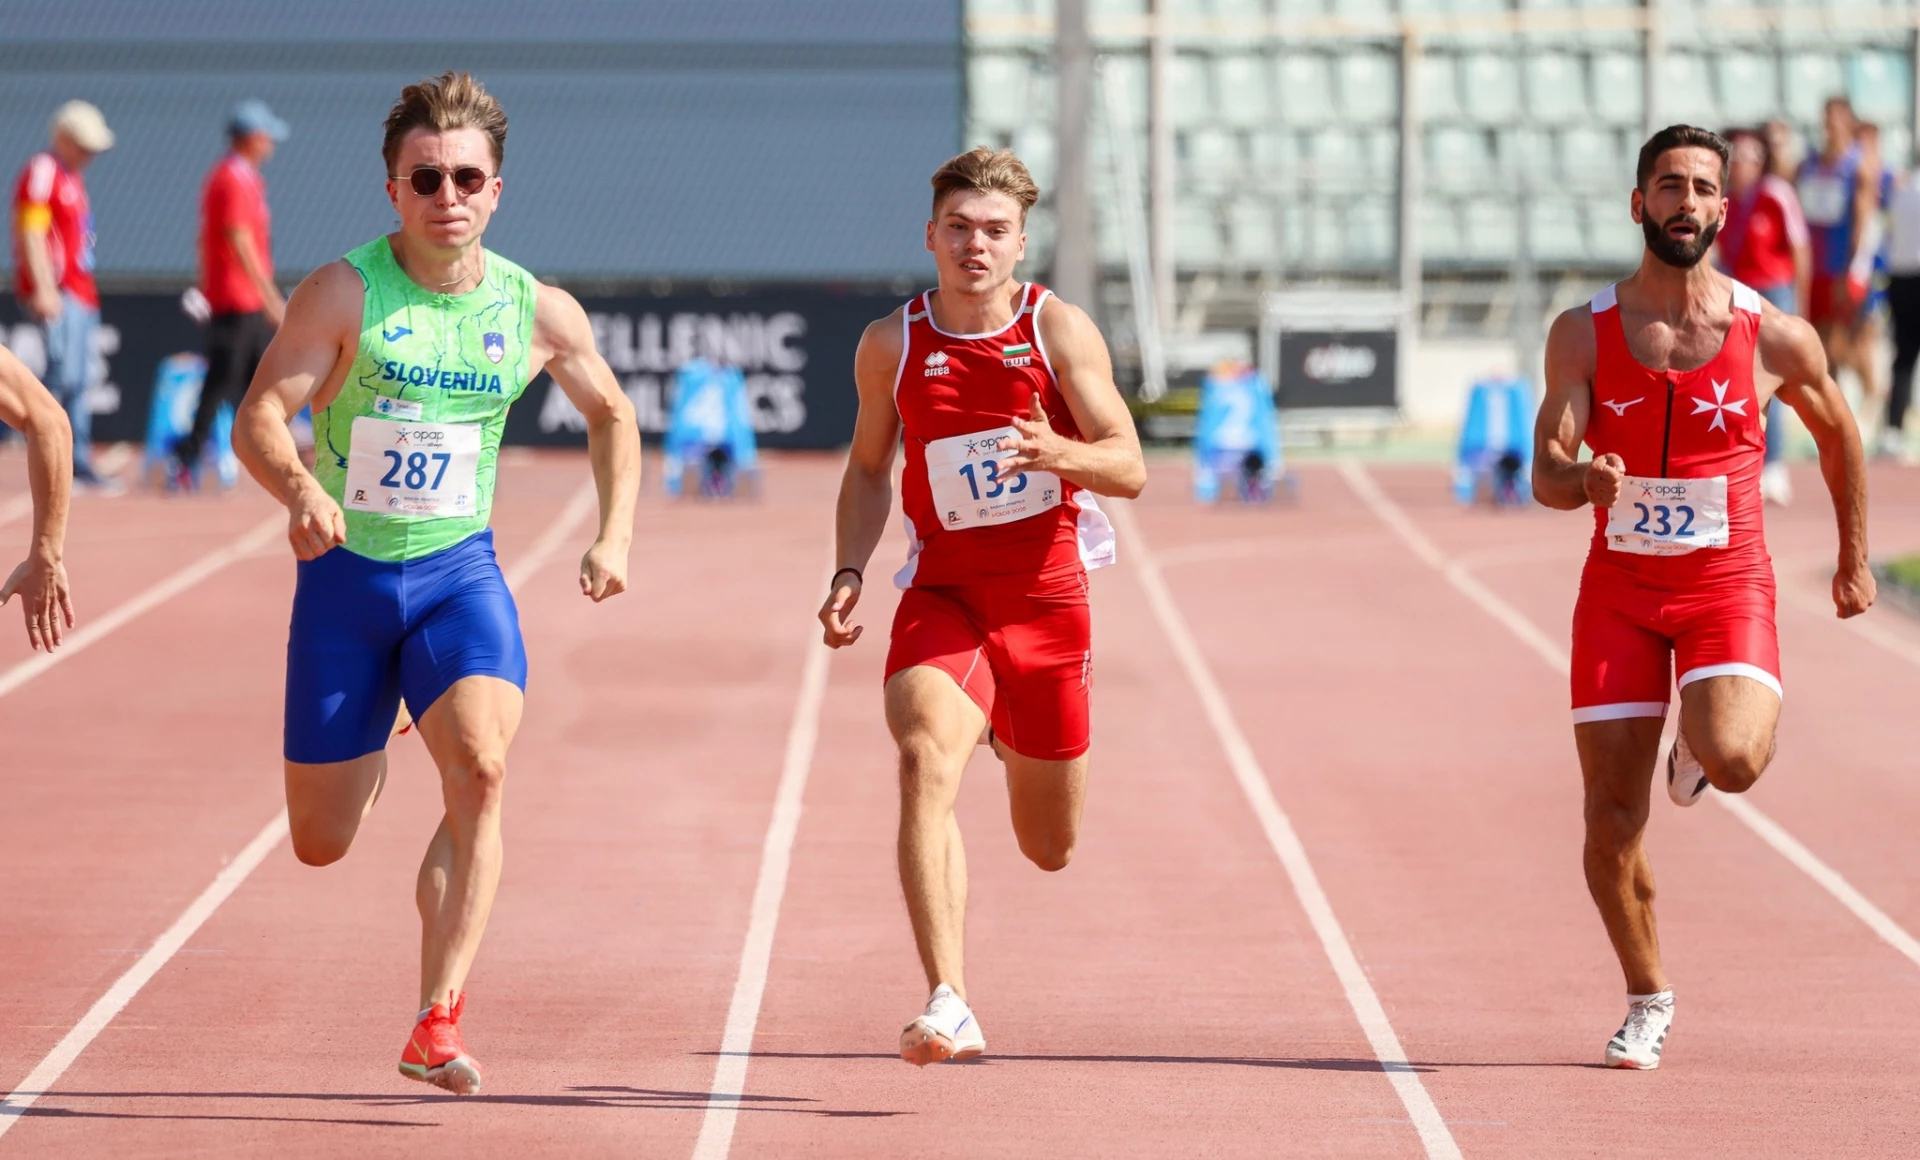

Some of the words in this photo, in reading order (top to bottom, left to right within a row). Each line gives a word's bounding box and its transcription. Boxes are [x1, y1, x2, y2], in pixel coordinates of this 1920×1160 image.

[1005, 359, 1028, 367] BUL
[382, 361, 502, 394] SLOVENIJA
[924, 366, 950, 377] errea
[1218, 390, 1257, 450] 2
[413, 431, 444, 442] opap
[980, 435, 1011, 450] opa
[379, 450, 451, 490] 287
[1656, 485, 1686, 497] opap
[1633, 502, 1695, 536] 232
